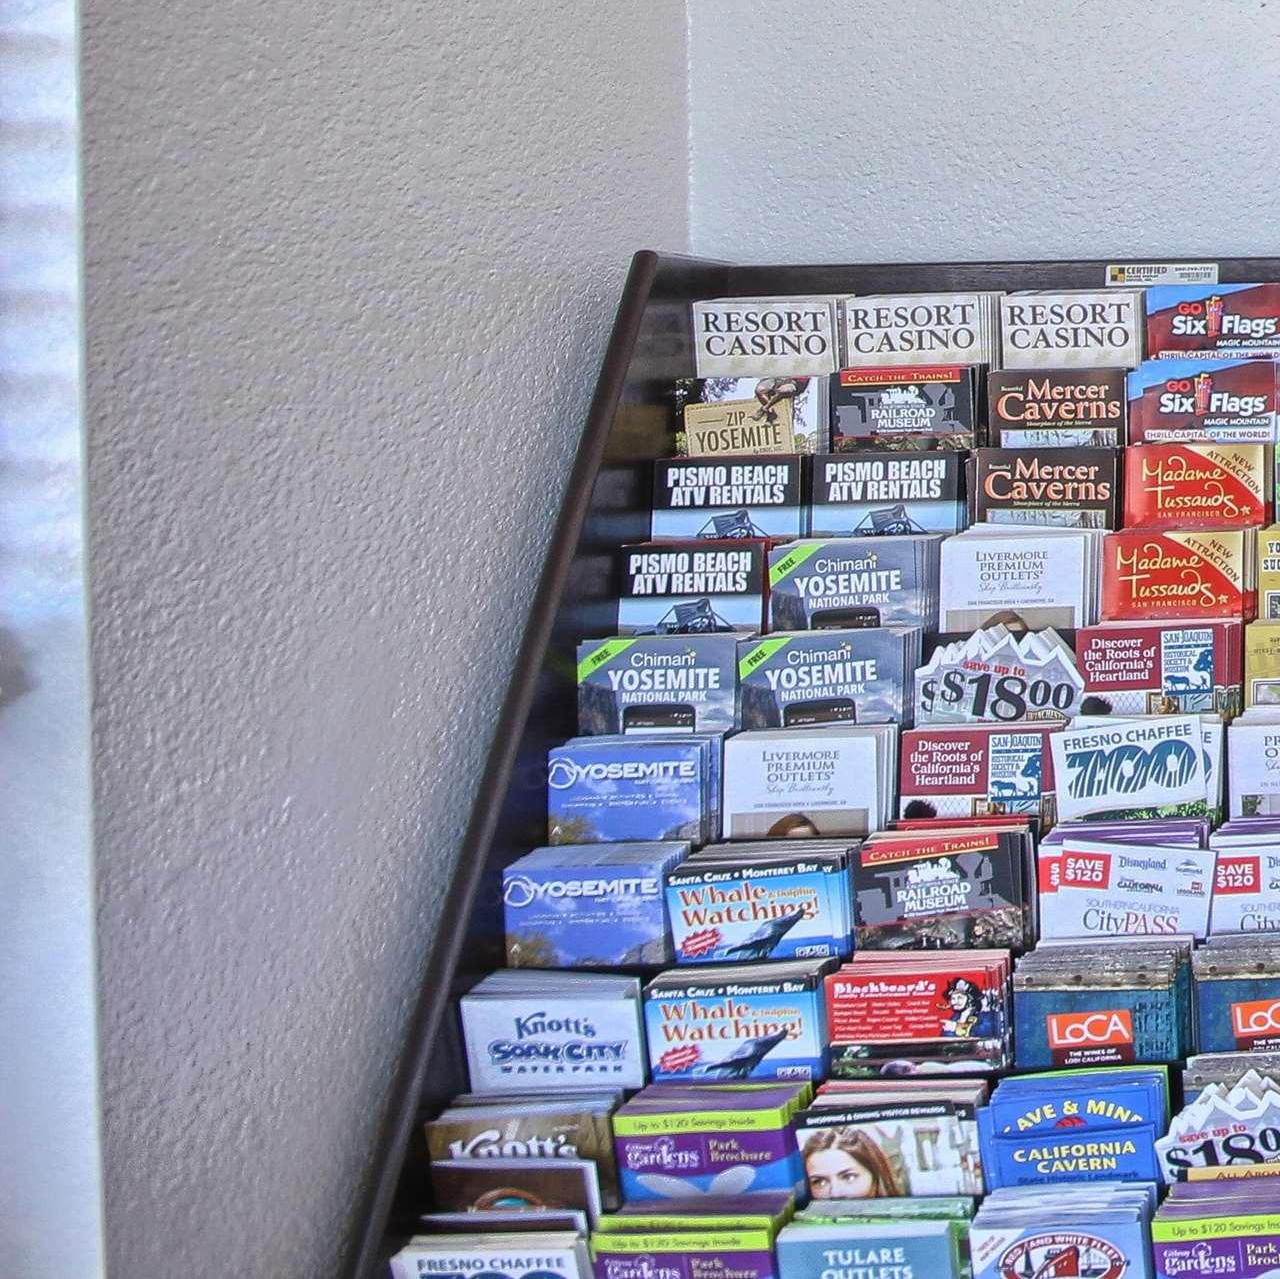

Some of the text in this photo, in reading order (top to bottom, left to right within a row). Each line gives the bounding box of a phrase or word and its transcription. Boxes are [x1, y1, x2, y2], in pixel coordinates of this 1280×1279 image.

[1126, 267, 1168, 275] CERTIFIED
[852, 303, 975, 330] RESORT
[1007, 302, 1131, 327] RESORT
[1178, 303, 1202, 315] GO
[702, 311, 826, 333] RESORT
[1172, 314, 1278, 337] Six Flags
[705, 334, 827, 356] CASINO
[854, 327, 975, 354] CASINO
[1010, 326, 1130, 349] CASINO
[1026, 378, 1110, 401] Mercer
[1166, 381, 1191, 392] GO
[871, 407, 936, 420] RAILROAD
[996, 391, 1122, 422] Caverns
[1159, 393, 1266, 416] Six Flags
[726, 411, 746, 427] ZIP
[877, 418, 931, 430] MUSEUM
[695, 423, 783, 454] YOSEMITE
[825, 459, 946, 483] PISMO BEACH
[1015, 457, 1099, 480] Mercer
[1142, 455, 1227, 483] Madame
[1231, 453, 1256, 471] NEW
[667, 465, 789, 488] PISMO BEACH
[1206, 450, 1261, 494] ATTRACTION
[670, 484, 785, 506] ATV RENTALS
[828, 479, 942, 502] ATV RENTALS
[983, 471, 1111, 501] Caverns
[1143, 481, 1239, 518] Tussauds
[975, 550, 1048, 562] LIVERMORE
[1116, 543, 1204, 572] Madame
[1209, 539, 1233, 559] NEW
[629, 551, 751, 574] PISMO BEACH
[777, 557, 797, 575] FREE
[815, 556, 877, 574] Chimani
[980, 561, 1044, 571] PREMIUM
[1184, 537, 1240, 583] ATTRACTION
[632, 572, 748, 594] ATV RENTALS
[794, 569, 901, 598] YOSEMITE
[1118, 570, 1217, 608] Tussauds
[809, 592, 890, 609] NATIONAL PARK
[1091, 638, 1143, 649] Discover
[590, 649, 612, 666] FREE
[631, 650, 696, 668] Chimani
[748, 649, 768, 667] FREE
[787, 648, 851, 666] Chimani
[1083, 647, 1156, 660] the Roots of
[765, 659, 877, 690] YOSEMITE
[1012, 666, 1026, 677] to
[1085, 659, 1154, 672] California's
[607, 667, 720, 691] YOSEMITE
[1090, 670, 1149, 683] Heartland
[621, 690, 707, 703] NATIONAL PARK
[781, 683, 865, 701] NATIONAL PARK
[918, 740, 971, 752] Discover
[1063, 723, 1192, 752] FRESNO CHAFFEE
[762, 750, 840, 762] LIVERMORE
[910, 750, 983, 762] the Roots of
[576, 761, 696, 779] YOSEMITE
[767, 761, 835, 772] PREMIUM
[911, 762, 980, 775] California's
[915, 773, 976, 786] Heartland
[1066, 858, 1104, 871] SAVE
[1118, 855, 1167, 871] Disneyland
[1216, 864, 1254, 876] SAVE
[1065, 870, 1103, 882] $120
[1216, 876, 1254, 888] $120
[534, 878, 658, 897] YOSEMITE
[679, 882, 766, 907] Whale
[896, 882, 971, 903] RAILROAD
[681, 897, 820, 927] Watching!
[904, 895, 966, 912] MUSEUM
[1083, 908, 1178, 934] CityPASS
[833, 980, 936, 994] Blackbeard's
[661, 998, 750, 1021] Whale
[515, 1012, 597, 1039] Knott's
[662, 1018, 802, 1041] Watching!
[1062, 1100, 1079, 1114] &
[1234, 1124, 1247, 1133] to
[448, 1128, 578, 1158] Knott's
[1013, 1140, 1136, 1163] CALIFORNIA
[1036, 1157, 1117, 1174] CAVERN
[1172, 1227, 1186, 1237] Up
[1189, 1227, 1198, 1235] to
[1201, 1223, 1227, 1234] $120
[1229, 1221, 1265, 1233] Savings
[823, 1247, 905, 1266] TULARE
[1029, 1234, 1120, 1261] AND WHITE FLEET
[1246, 1242, 1277, 1255] Park
[416, 1256, 567, 1271] FRESNO CHAFFEE
[821, 1265, 913, 1279] OUTLETS
